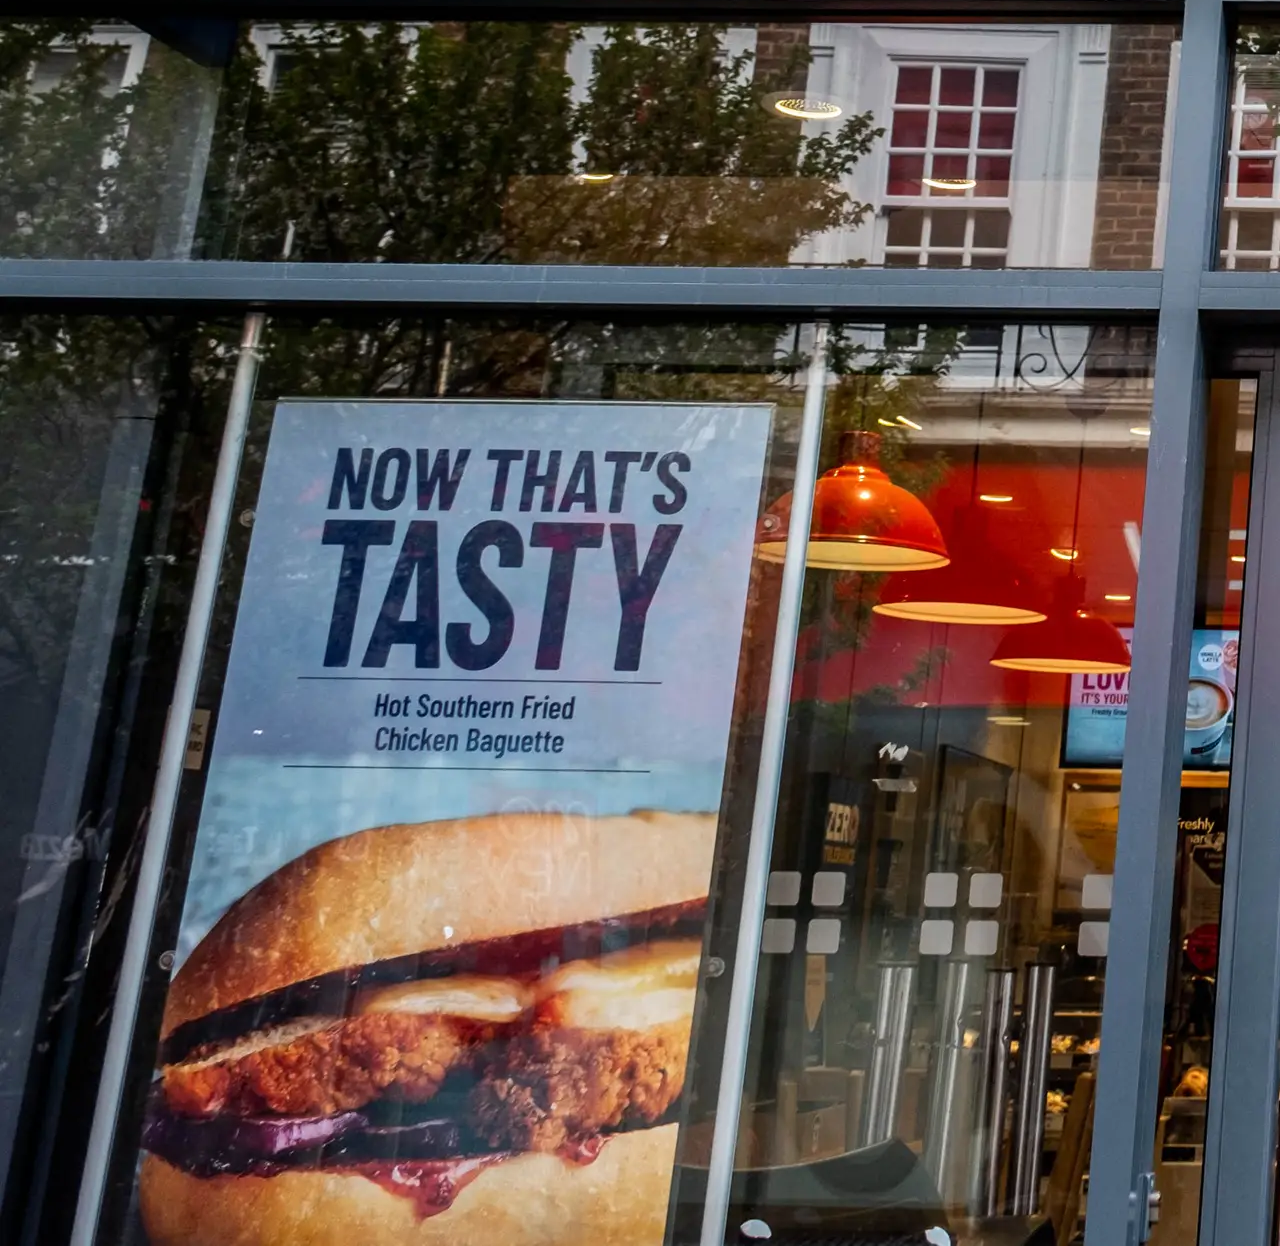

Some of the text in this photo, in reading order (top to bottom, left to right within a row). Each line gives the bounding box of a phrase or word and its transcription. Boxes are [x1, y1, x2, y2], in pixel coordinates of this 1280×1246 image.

[326, 447, 691, 515] NOW THAT'S
[321, 519, 684, 672] TASTY
[1082, 672, 1130, 690] LOV
[374, 693, 575, 721] Hot Southern Fried
[1081, 693, 1100, 704] IT'S
[374, 726, 565, 760] Chicken Baguette
[1177, 817, 1216, 836] reshly
